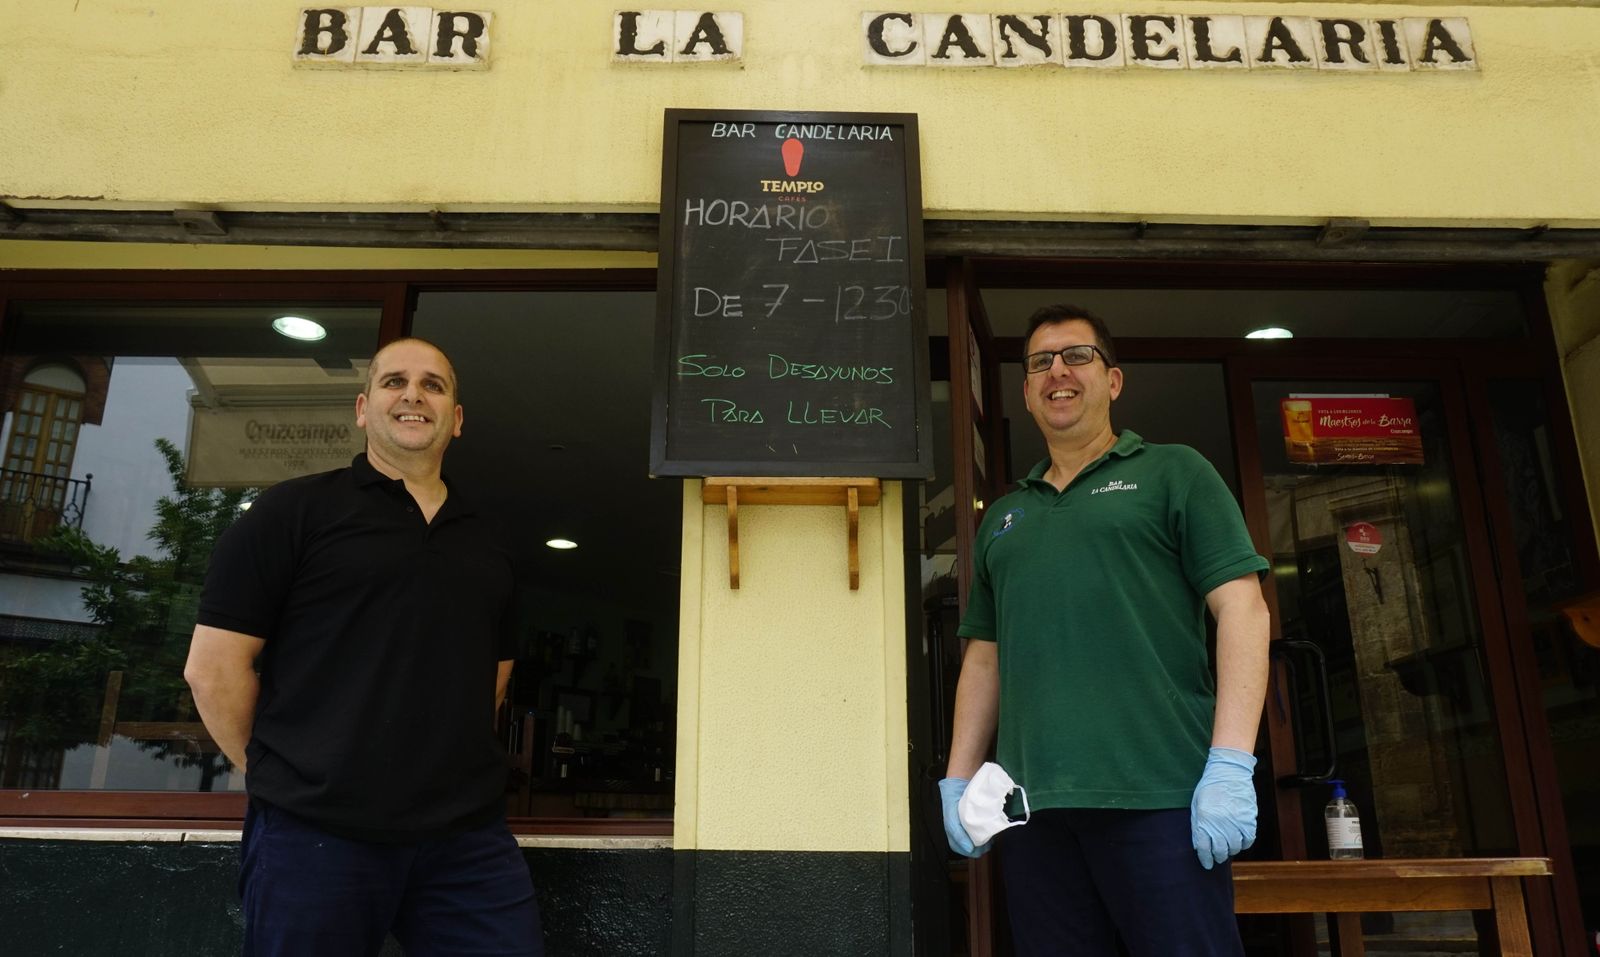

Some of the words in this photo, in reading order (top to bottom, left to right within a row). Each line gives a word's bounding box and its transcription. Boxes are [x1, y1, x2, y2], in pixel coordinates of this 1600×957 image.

[298, 9, 484, 58] BAR
[616, 11, 733, 56] LA
[867, 12, 1473, 65] CANDELARIA
[711, 122, 756, 138] BAR
[775, 123, 894, 141] CANDELARIA
[761, 180, 825, 193] TEMPLO
[684, 198, 831, 231] HORARIO
[694, 286, 743, 318] DE
[762, 284, 790, 318] 7
[768, 353, 894, 385] DESAYUNOS
[701, 398, 764, 423] PARA
[788, 401, 893, 429] LLEVAR
[1320, 415, 1361, 428] Maestros
[1378, 414, 1412, 427] Barra
